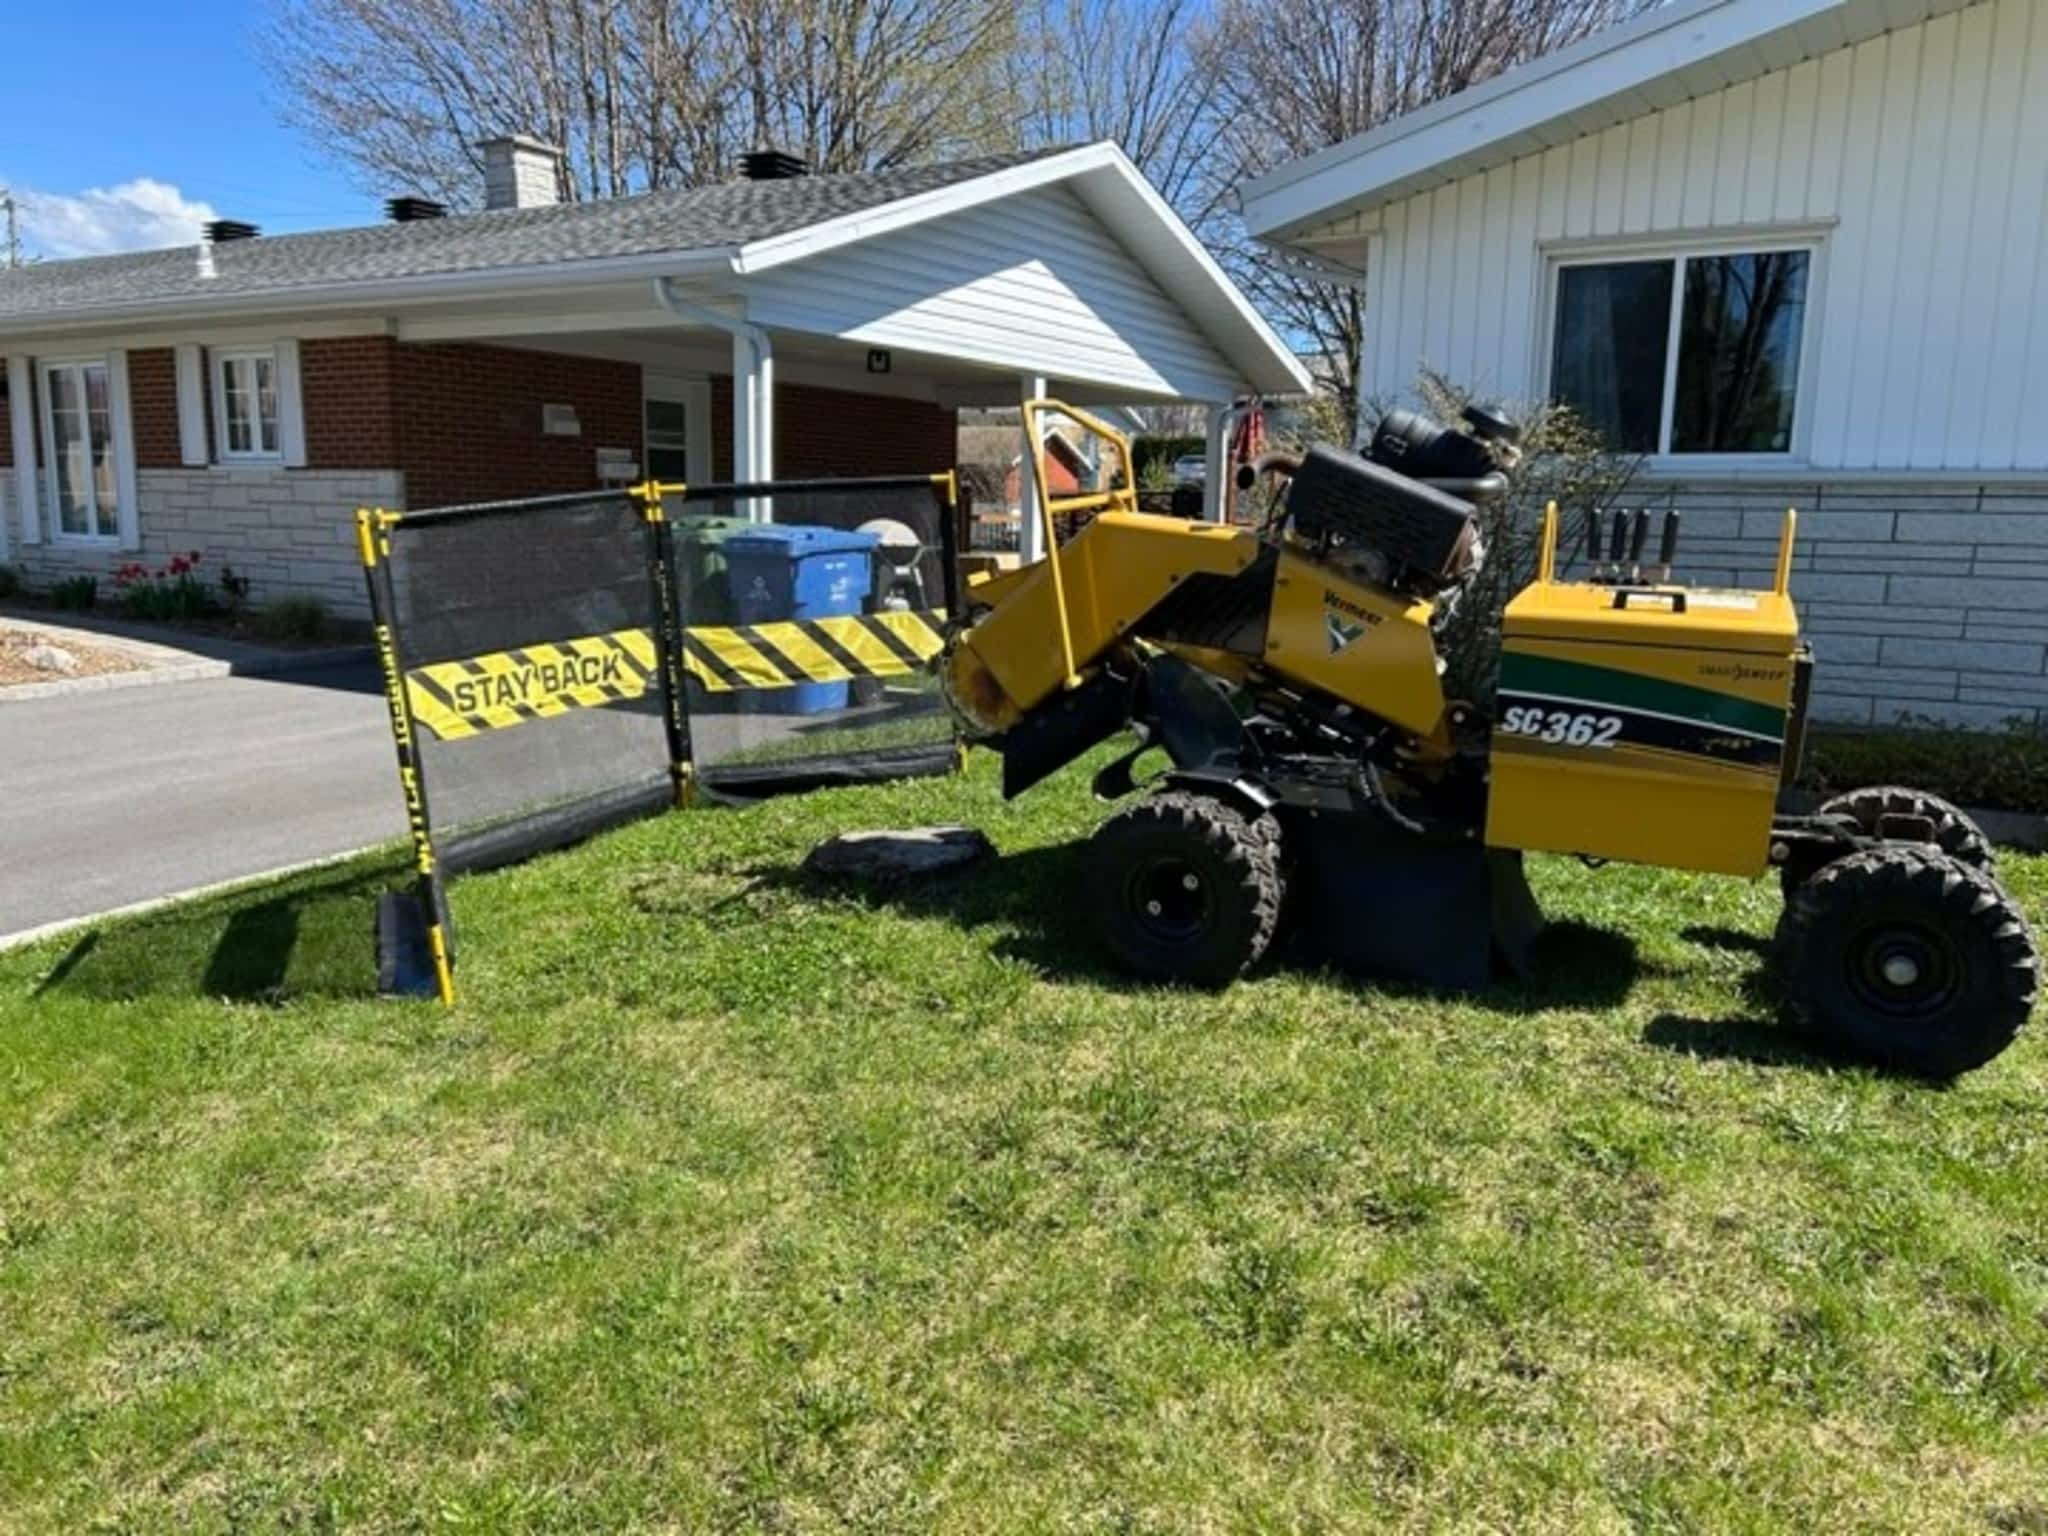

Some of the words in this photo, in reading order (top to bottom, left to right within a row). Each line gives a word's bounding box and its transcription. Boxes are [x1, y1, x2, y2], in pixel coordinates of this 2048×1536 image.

[454, 668, 531, 713] STAY
[541, 653, 622, 693] BACK
[1502, 705, 1623, 748] SC362
